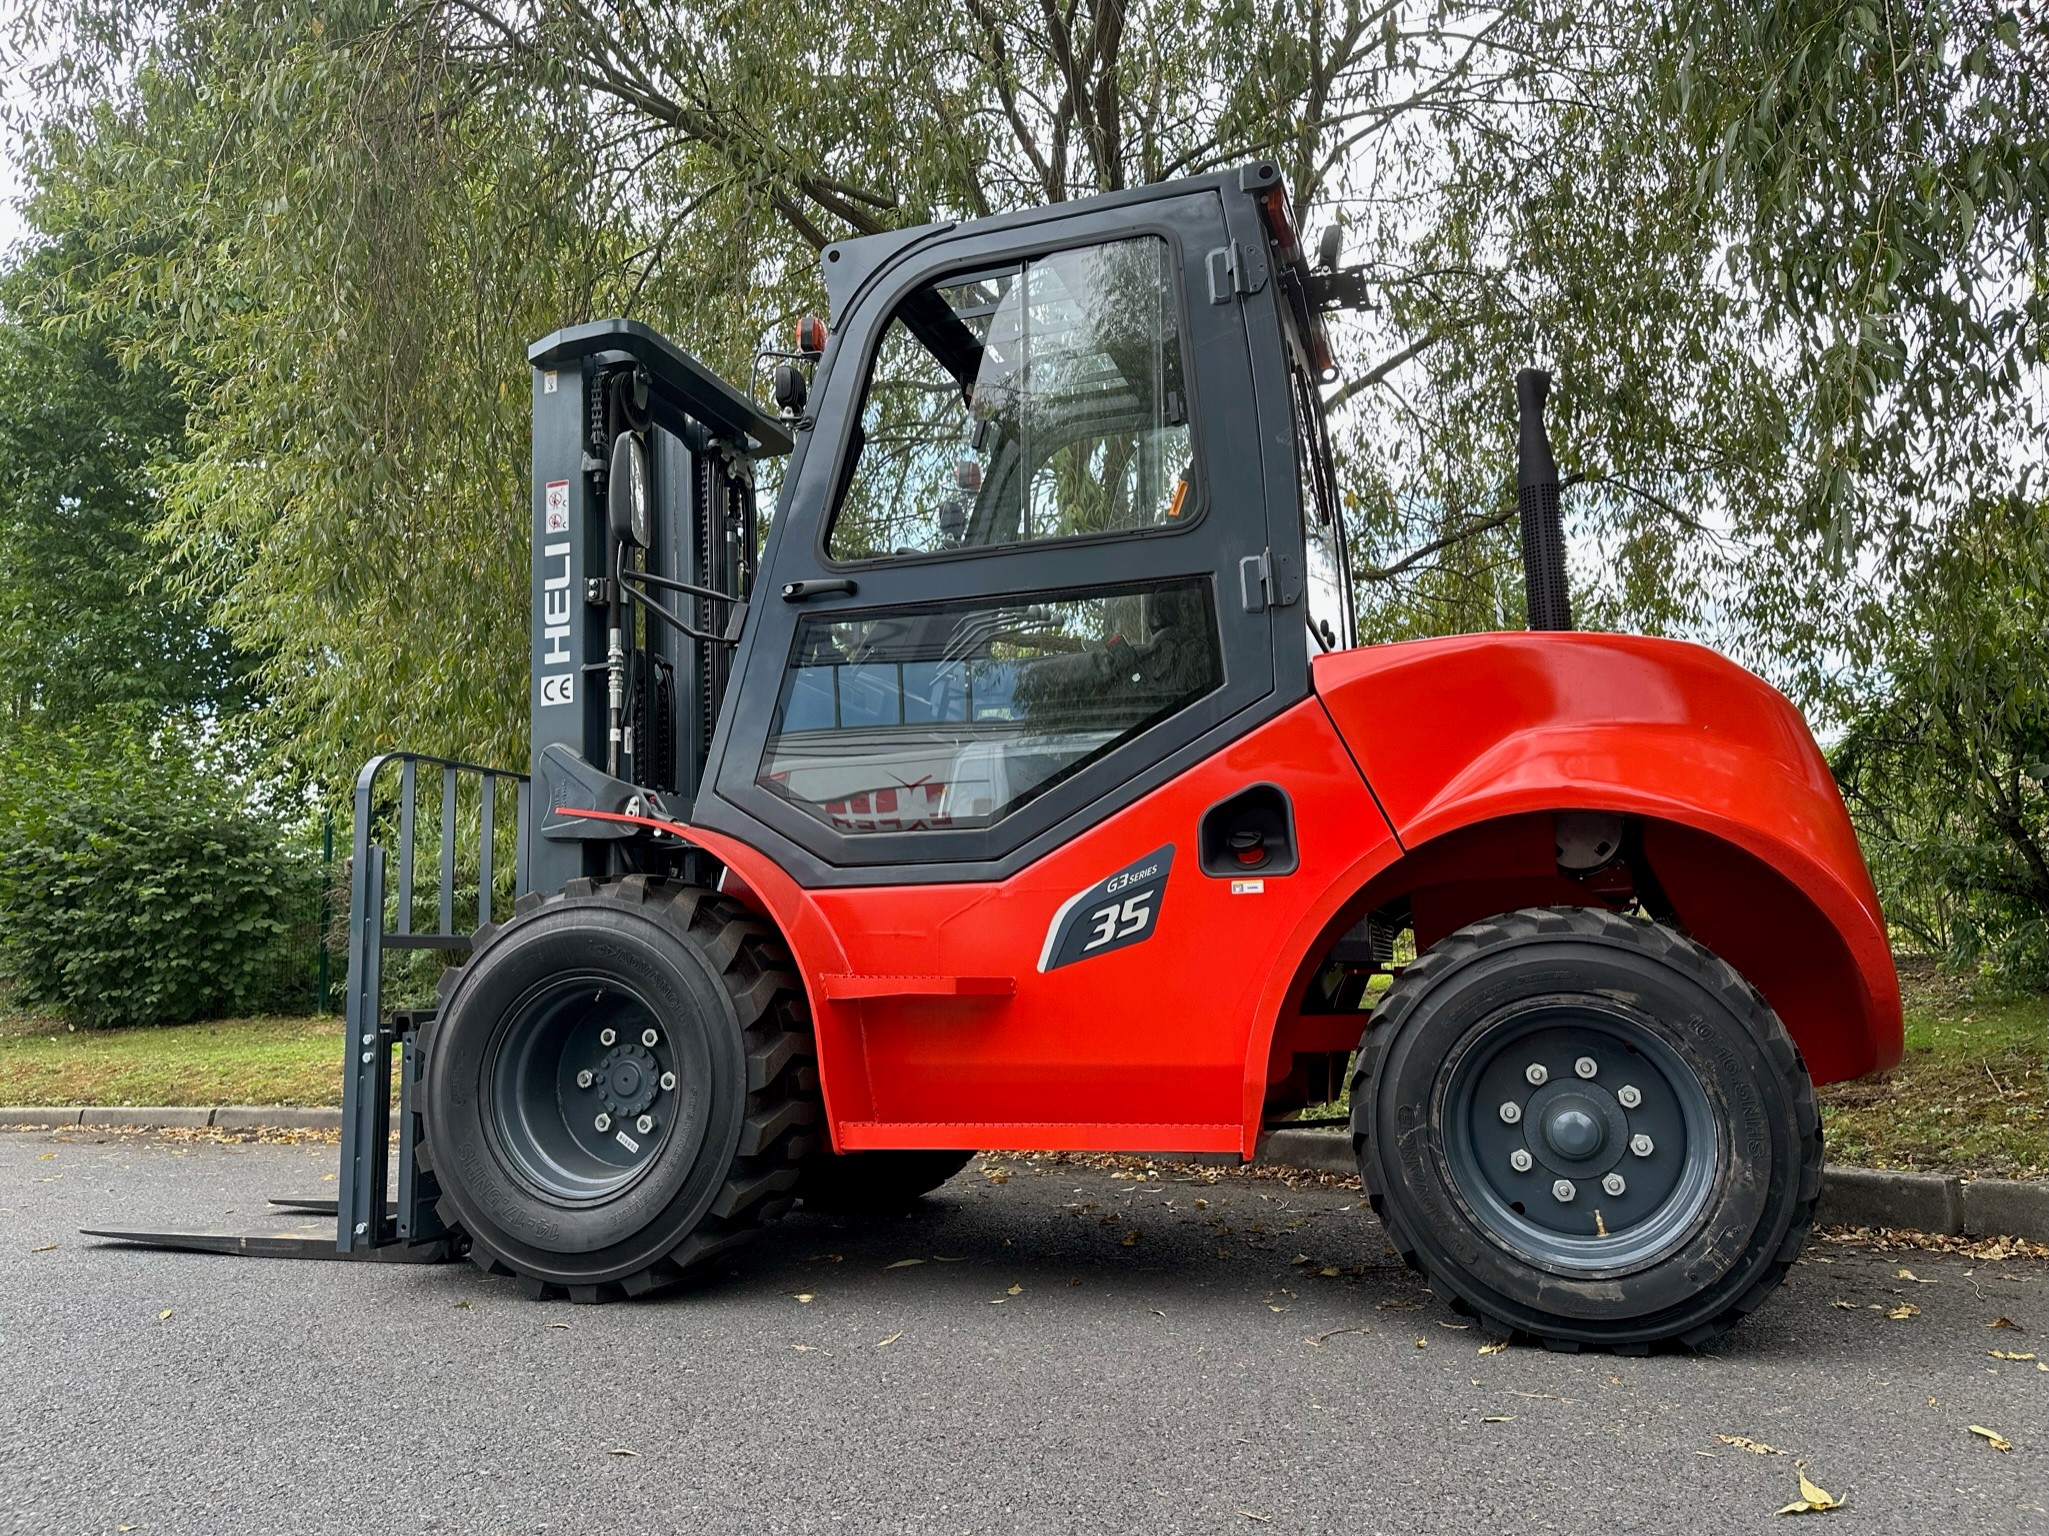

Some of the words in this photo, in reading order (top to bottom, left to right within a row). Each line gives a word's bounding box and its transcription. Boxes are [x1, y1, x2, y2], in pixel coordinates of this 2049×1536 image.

[544, 542, 571, 665] HELI
[543, 678, 571, 701] CE
[1106, 872, 1130, 893] G3
[1129, 864, 1158, 884] SERIES
[1083, 889, 1155, 952] 35
[457, 1141, 560, 1241] 14-17.5NHS
